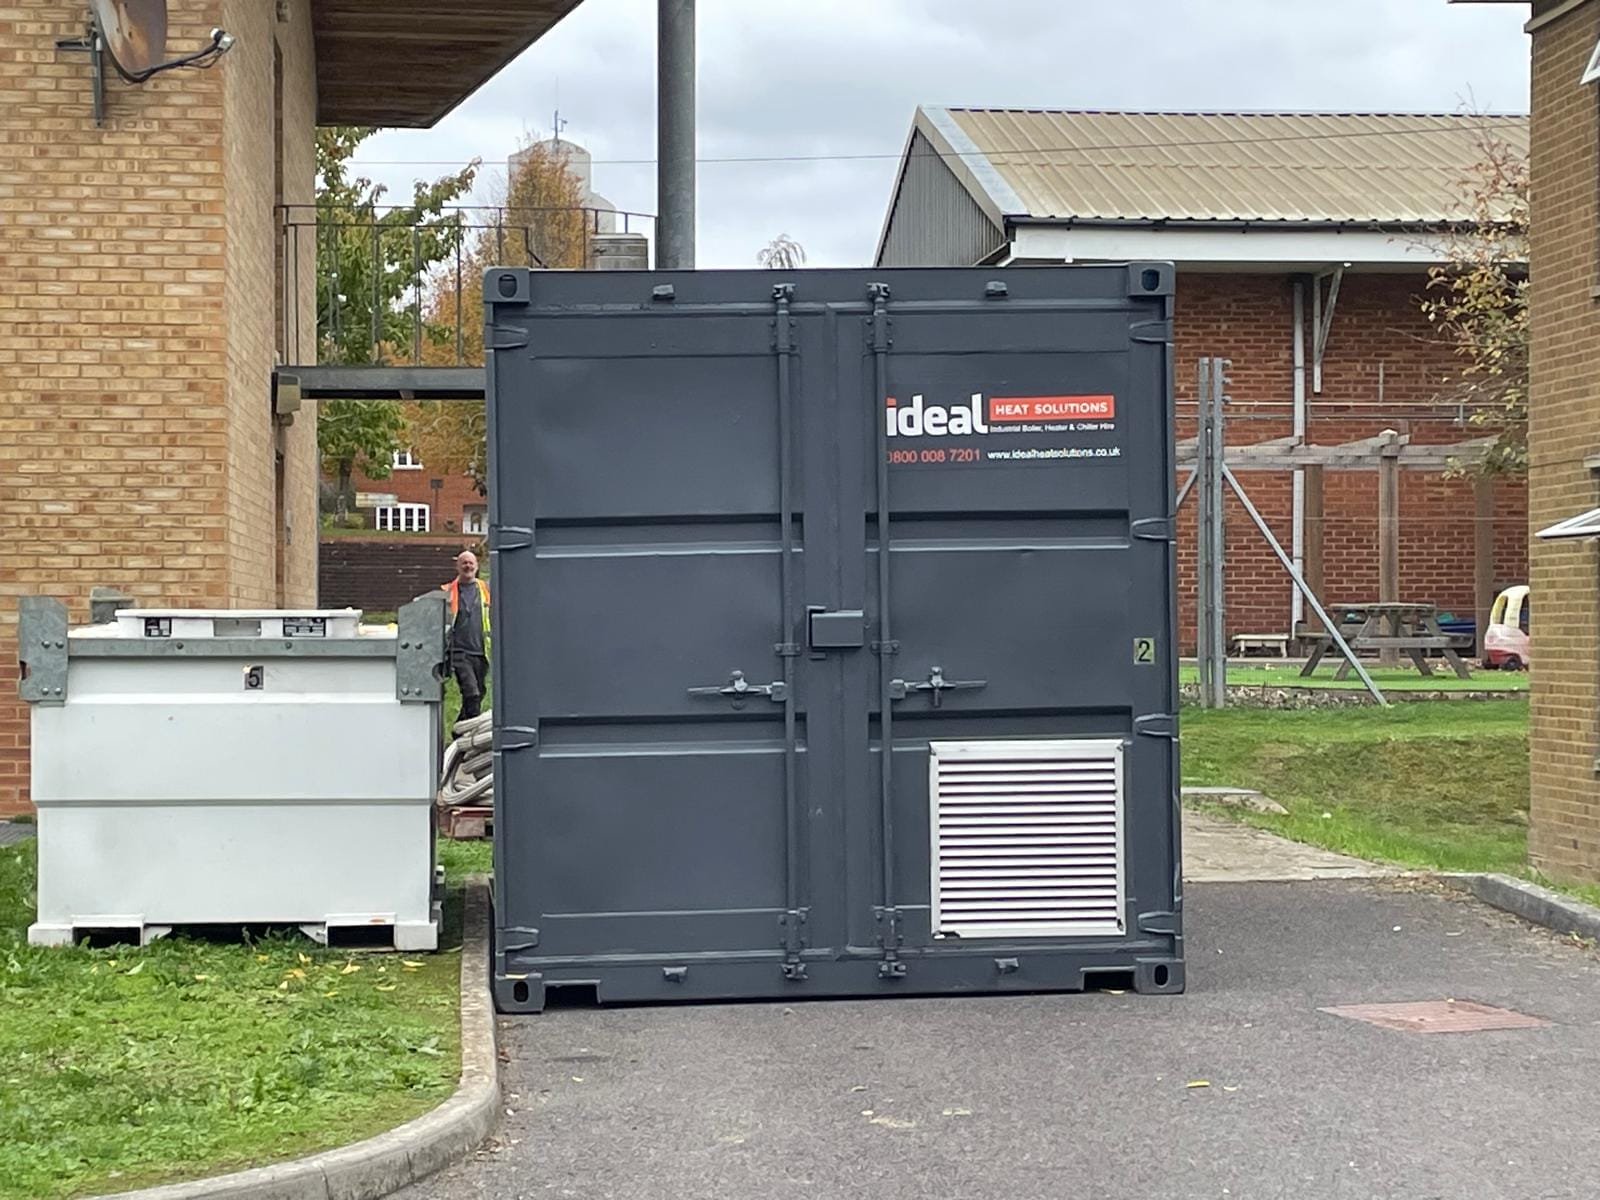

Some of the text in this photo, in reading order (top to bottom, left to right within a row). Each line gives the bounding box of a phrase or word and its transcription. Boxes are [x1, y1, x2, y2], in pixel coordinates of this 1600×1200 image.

[886, 393, 988, 436] ideal
[995, 402, 1108, 415] HEAT SOLUTIONS
[921, 449, 945, 463] 008
[949, 448, 980, 462] 7201
[987, 446, 1121, 459] www.idealheatsolutions.co.uk
[1138, 640, 1151, 662] 2
[248, 666, 261, 688] 5
